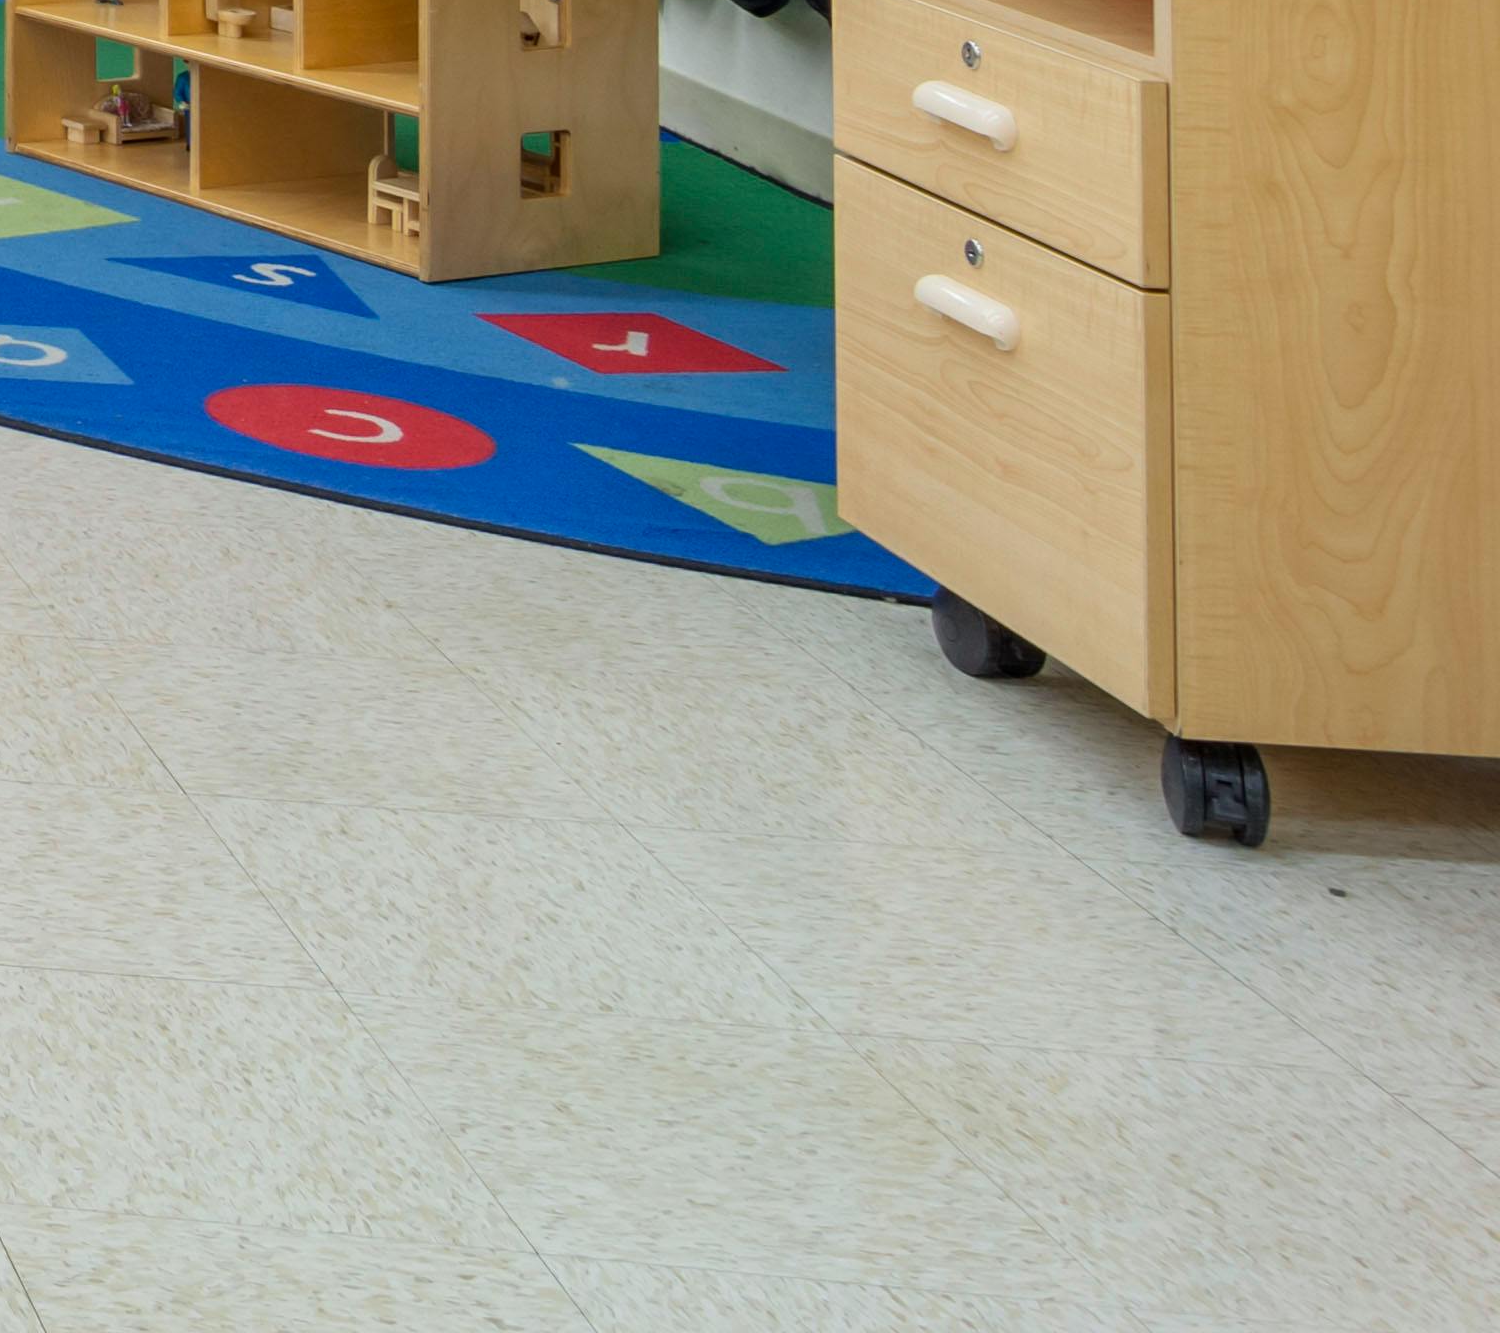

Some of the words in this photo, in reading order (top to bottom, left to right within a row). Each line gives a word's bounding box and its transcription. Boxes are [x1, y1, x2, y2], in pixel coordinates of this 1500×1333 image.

[233, 263, 316, 286] s
[592, 330, 648, 357] r
[309, 409, 403, 443] c
